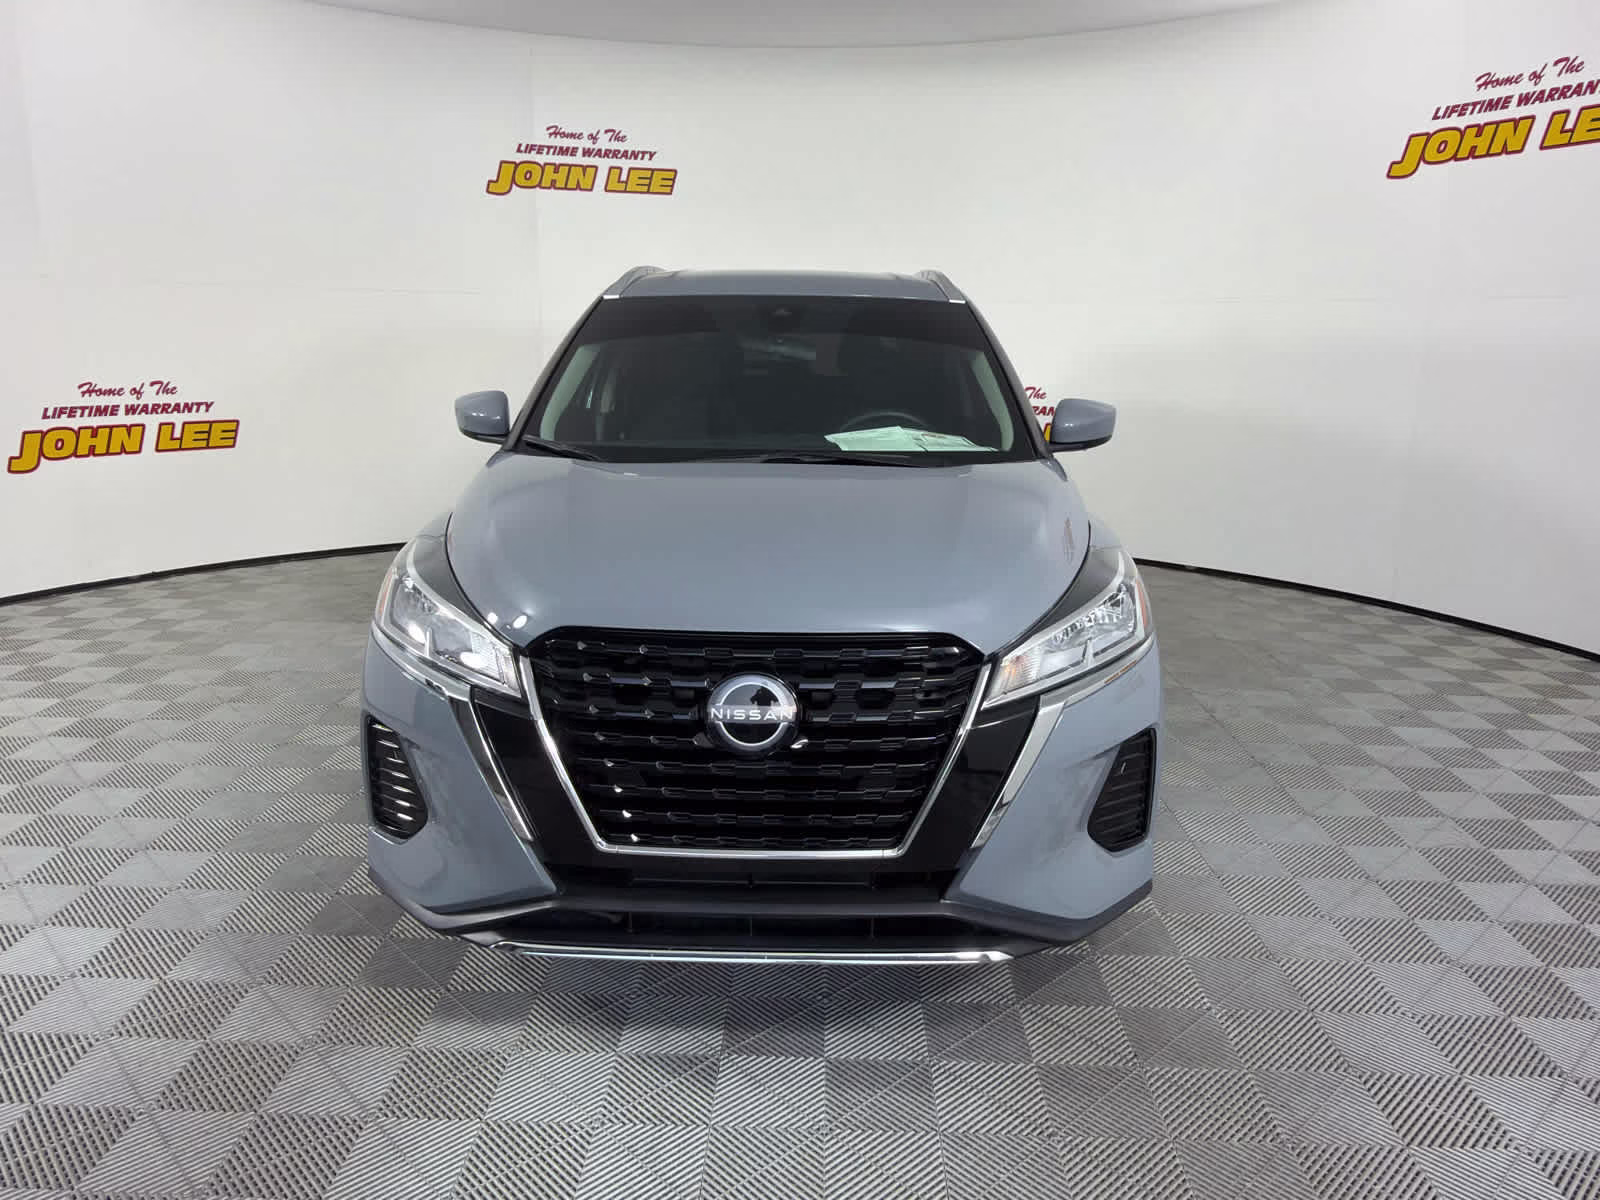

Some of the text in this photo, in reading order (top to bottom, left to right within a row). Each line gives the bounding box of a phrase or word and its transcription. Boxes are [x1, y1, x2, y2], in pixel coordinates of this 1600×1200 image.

[1475, 56, 1585, 92] Home of The
[1432, 80, 1600, 121] LIFETIME WARRAN
[546, 125, 628, 144] Home of The
[1386, 115, 1536, 179] JOHN
[516, 144, 656, 161] LIFETIME WARRANTY
[486, 160, 677, 195] JOHN LEE
[77, 381, 178, 400] Home of The
[42, 401, 214, 420] LIFETIME WARRANTY
[8, 419, 240, 474] JOHN LEE
[711, 707, 793, 721] NISSAN
